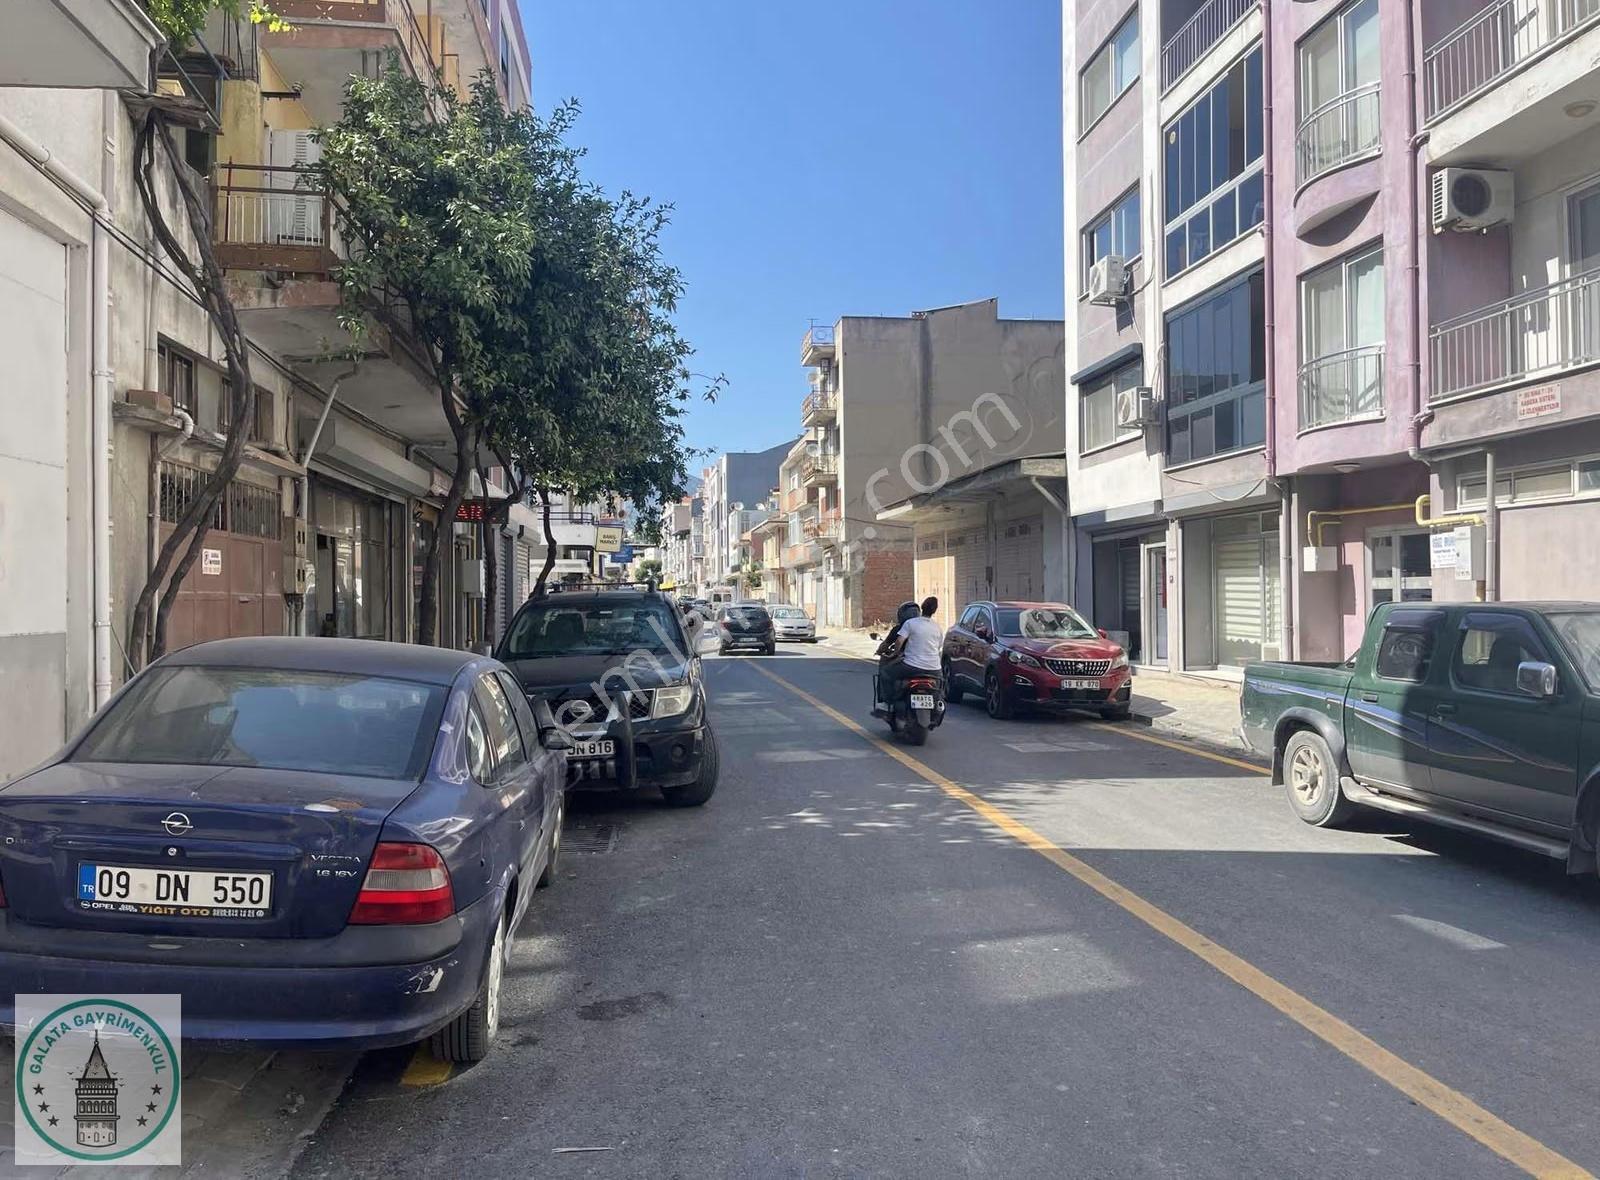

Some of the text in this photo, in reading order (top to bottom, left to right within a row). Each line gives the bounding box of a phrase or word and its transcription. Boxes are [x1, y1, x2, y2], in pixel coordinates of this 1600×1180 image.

[589, 742, 611, 754] 816
[82, 869, 264, 904] TR 09 DN 550
[92, 902, 116, 910] OPEL
[181, 908, 210, 916] OTO
